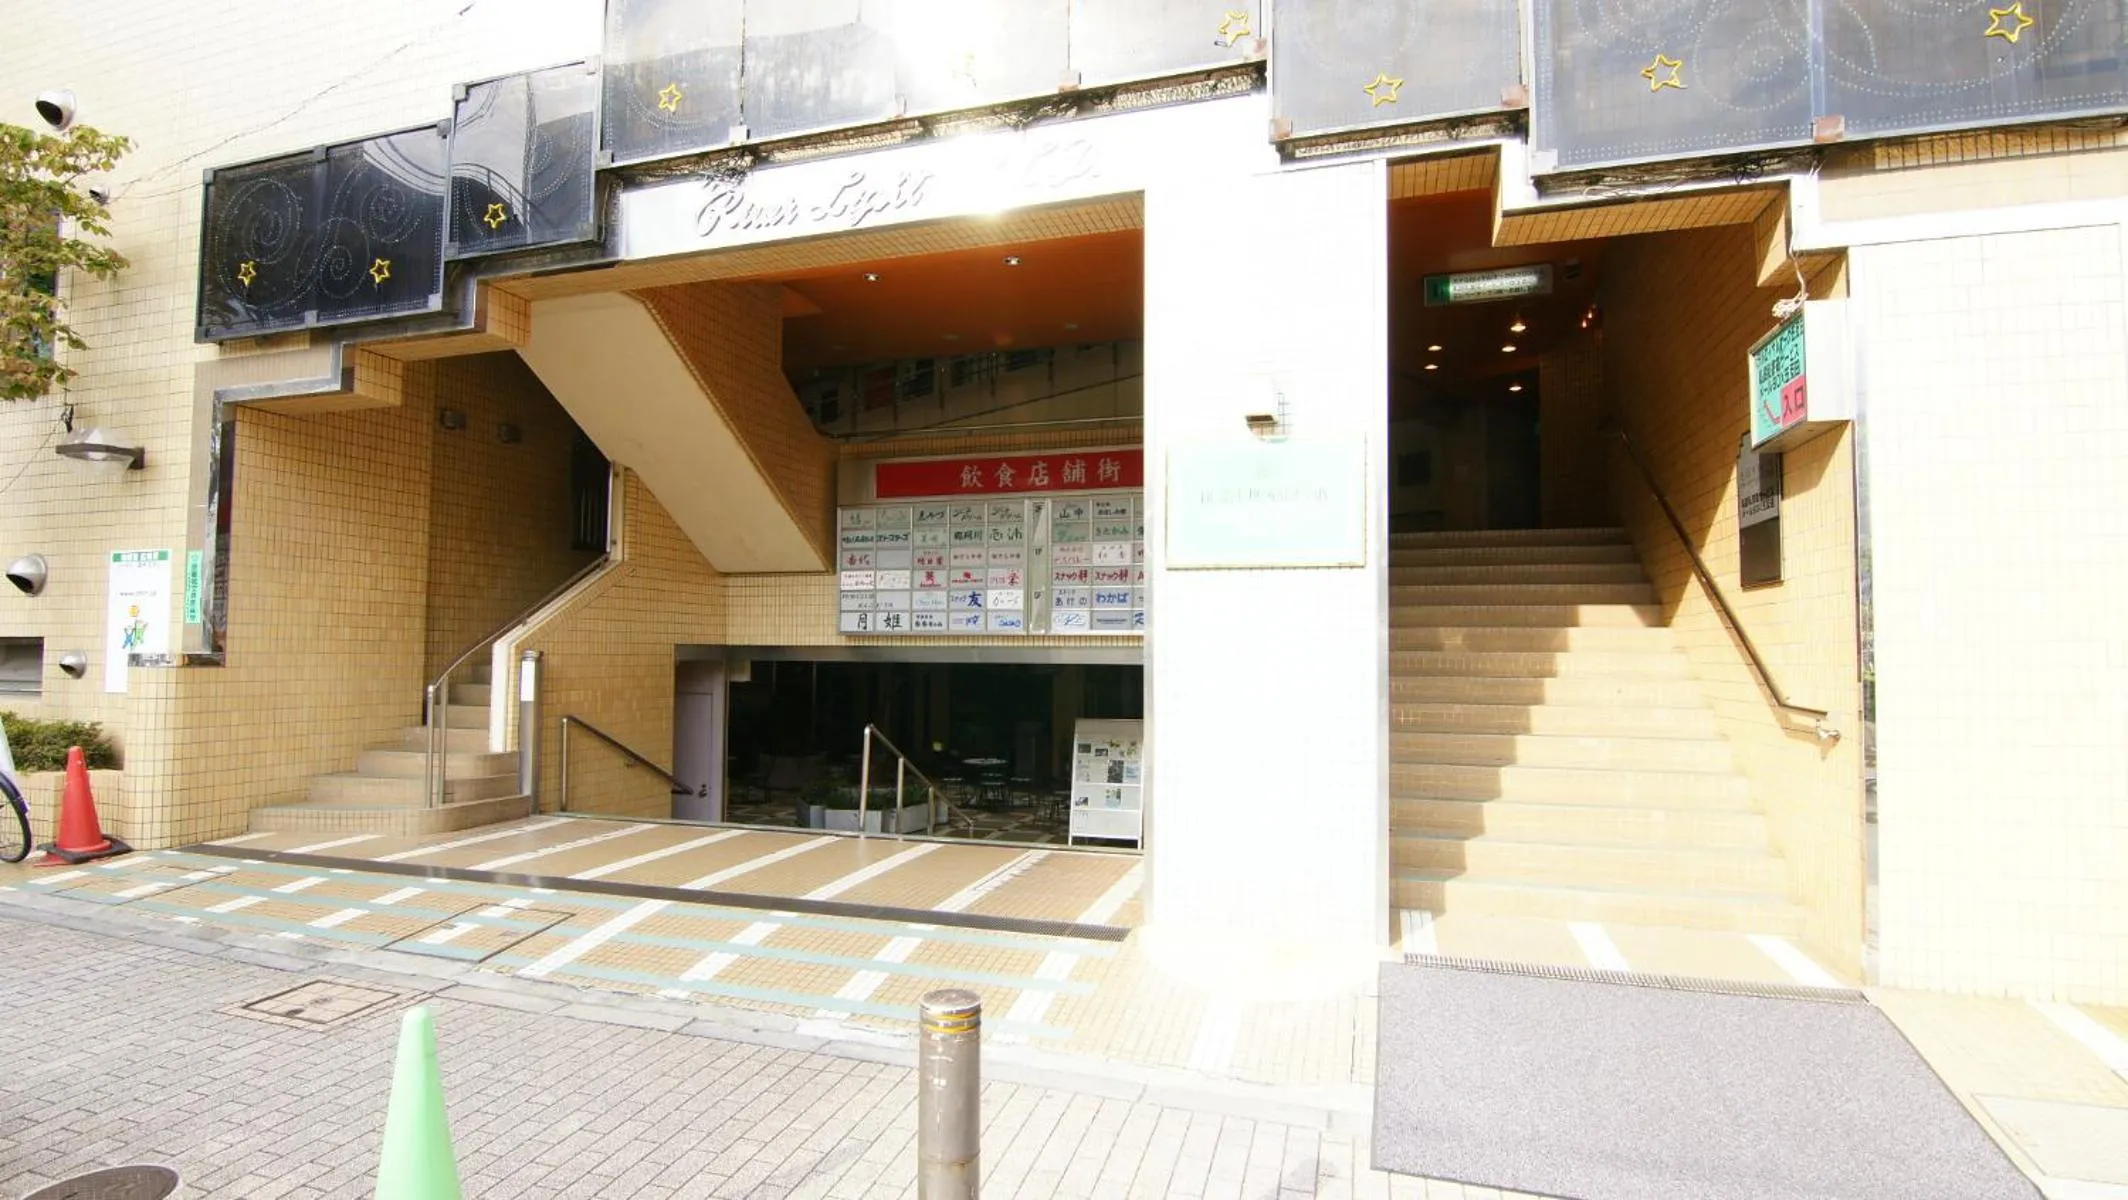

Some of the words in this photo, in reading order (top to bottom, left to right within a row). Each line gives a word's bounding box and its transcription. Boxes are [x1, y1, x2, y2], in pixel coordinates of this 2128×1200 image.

[1782, 387, 1804, 415] 入口
[959, 458, 1121, 488] 飲食店舗街
[1095, 592, 1130, 604] わかば
